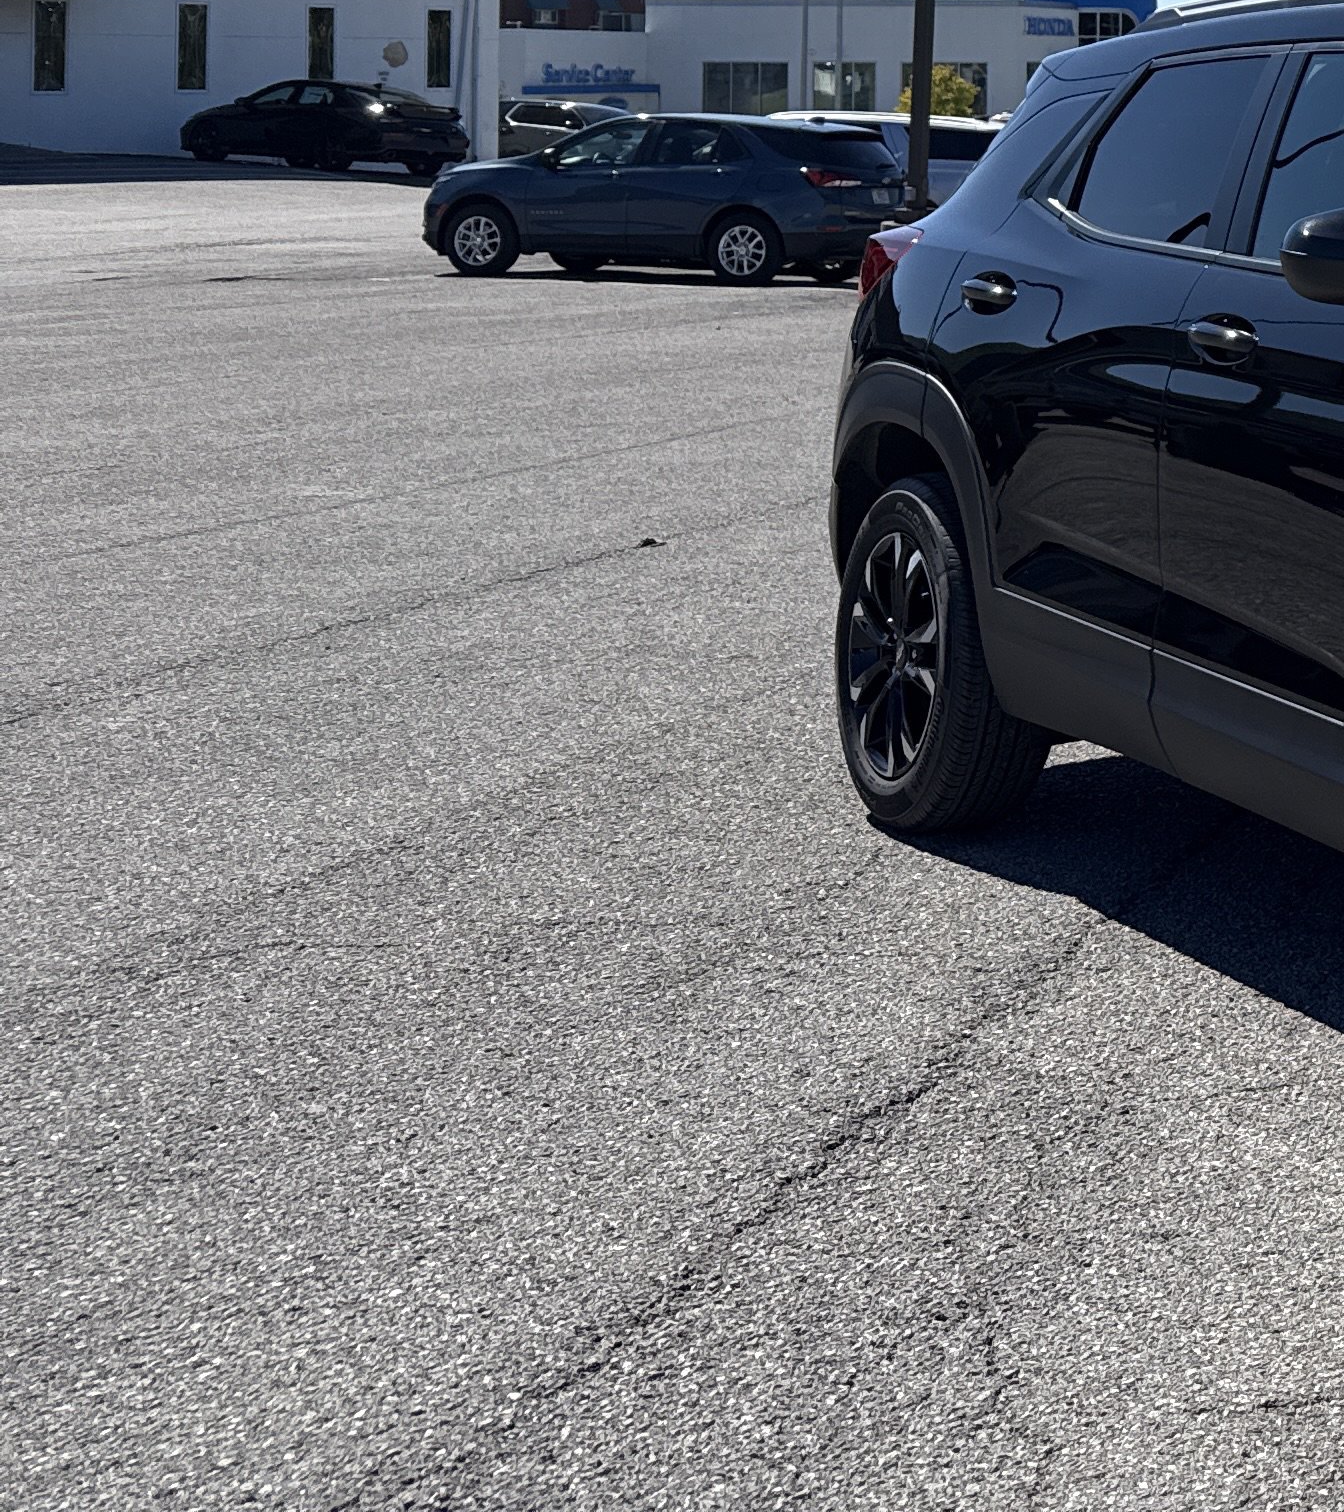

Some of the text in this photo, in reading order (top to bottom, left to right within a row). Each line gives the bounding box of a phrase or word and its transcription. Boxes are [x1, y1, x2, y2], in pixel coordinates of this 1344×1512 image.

[1025, 16, 1075, 37] HONDA
[542, 63, 635, 83] Service Center
